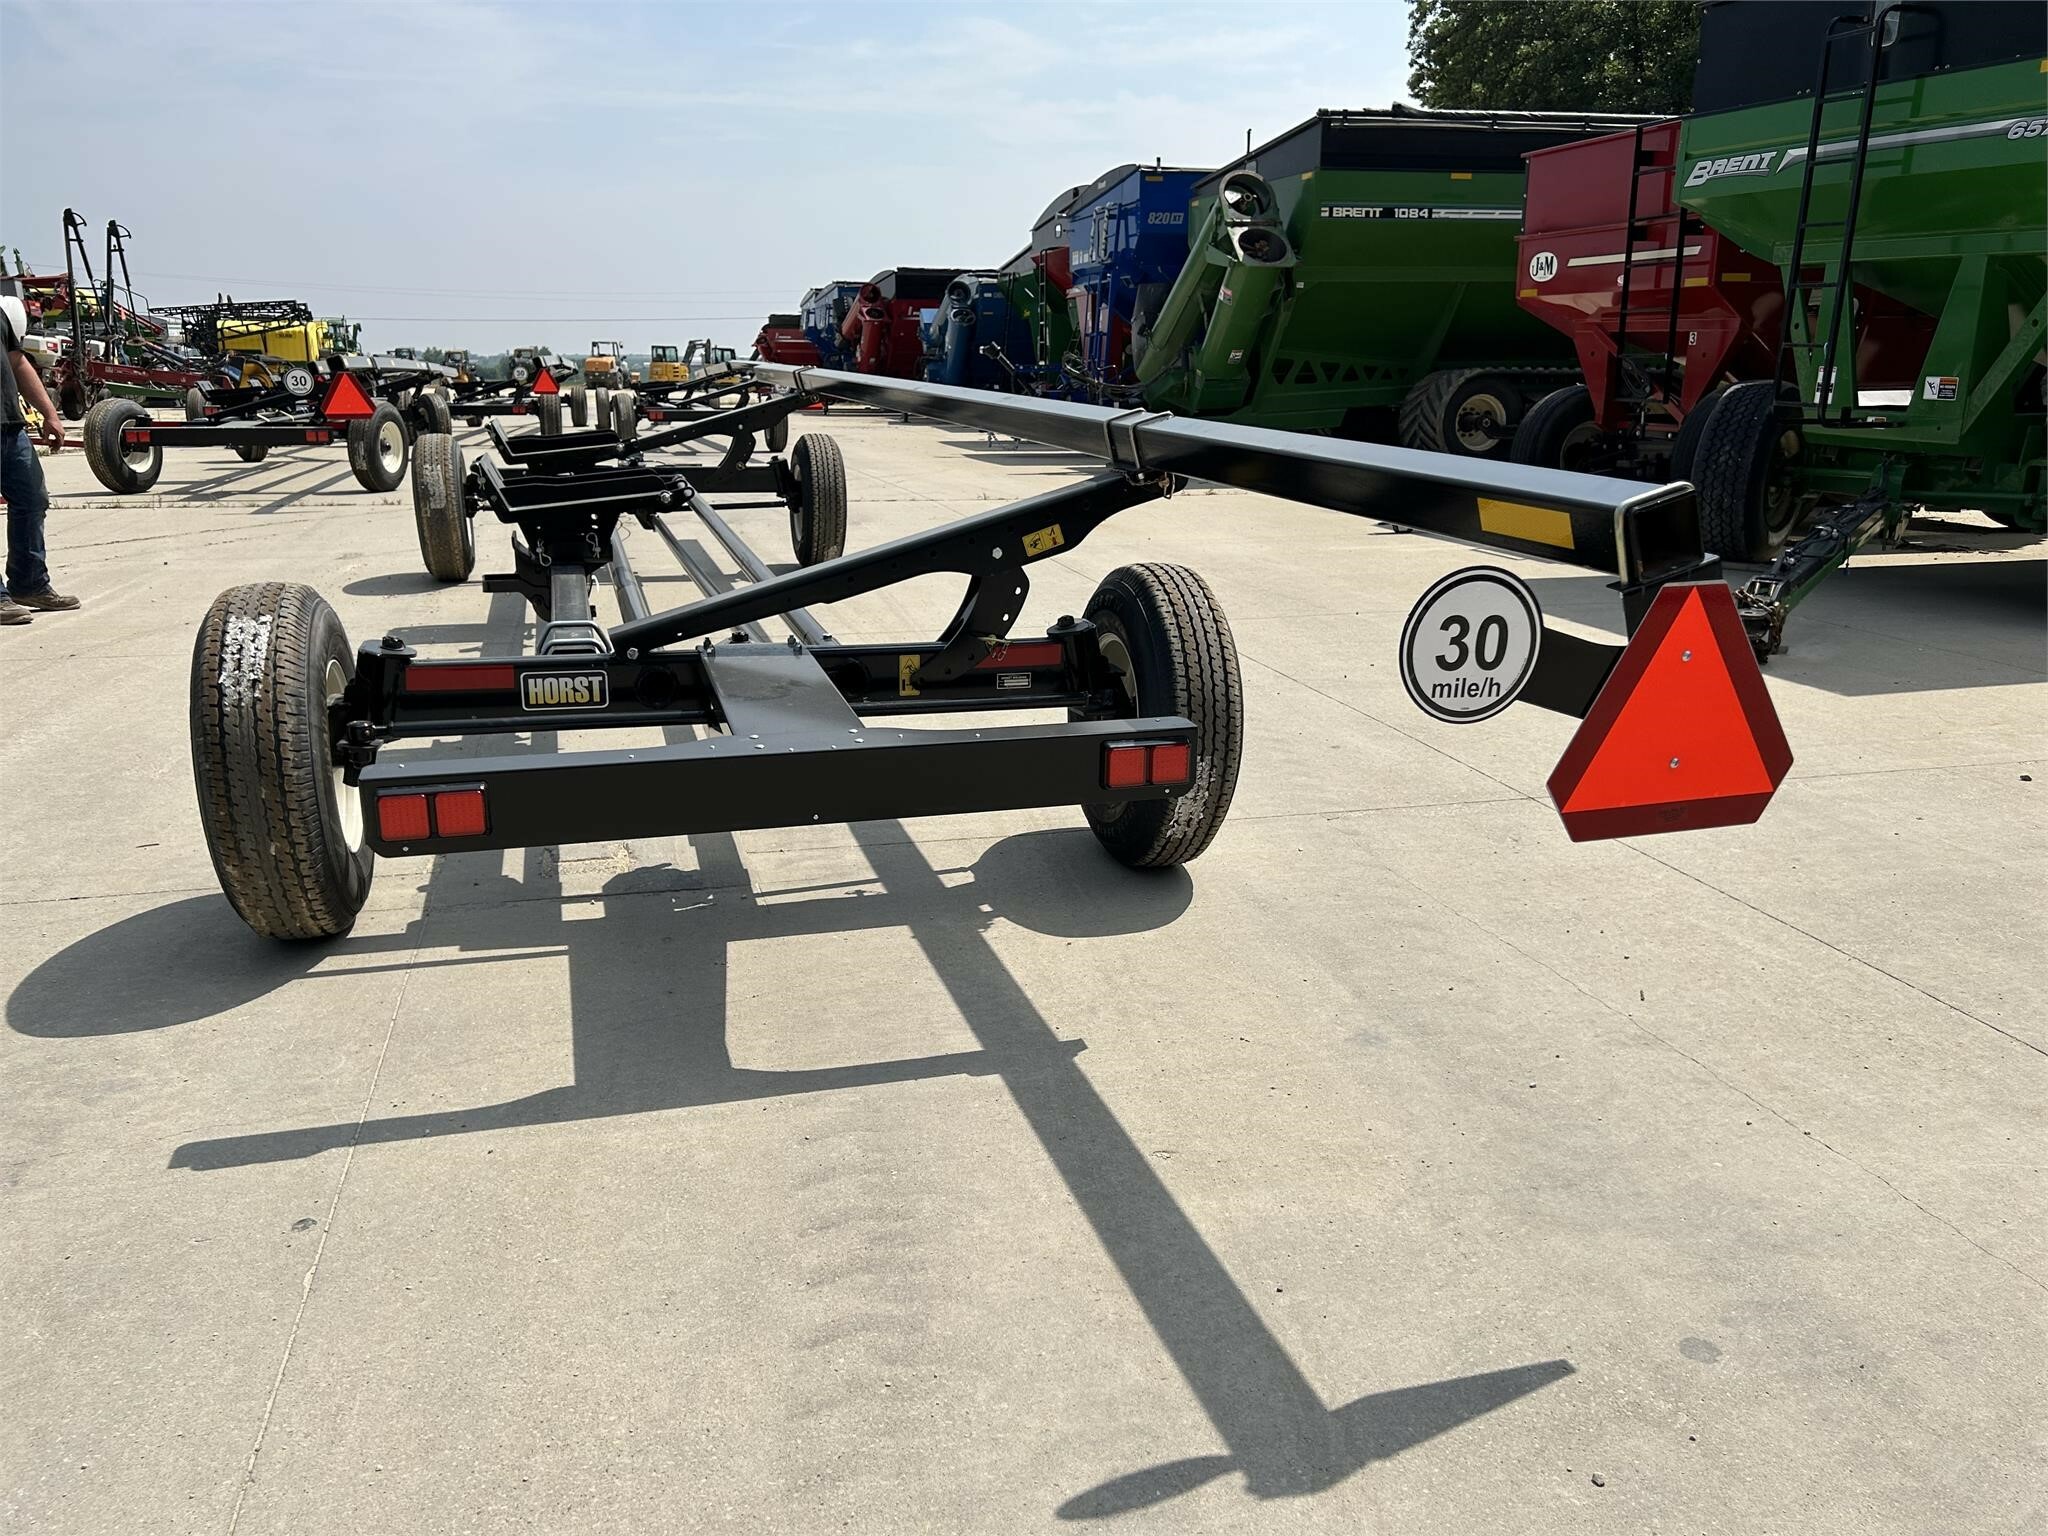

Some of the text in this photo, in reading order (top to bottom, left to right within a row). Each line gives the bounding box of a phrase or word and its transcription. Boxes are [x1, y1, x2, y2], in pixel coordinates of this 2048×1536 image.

[1684, 151, 1778, 188] BRENT
[1147, 211, 1170, 224] 820
[1332, 207, 1430, 219] BRENT 1084
[1532, 255, 1555, 276] J&M
[1689, 332, 1696, 344] 3
[291, 375, 307, 387] 30
[1435, 614, 1509, 672] 30
[527, 676, 602, 705] HORST
[1431, 677, 1502, 699] mile/h
